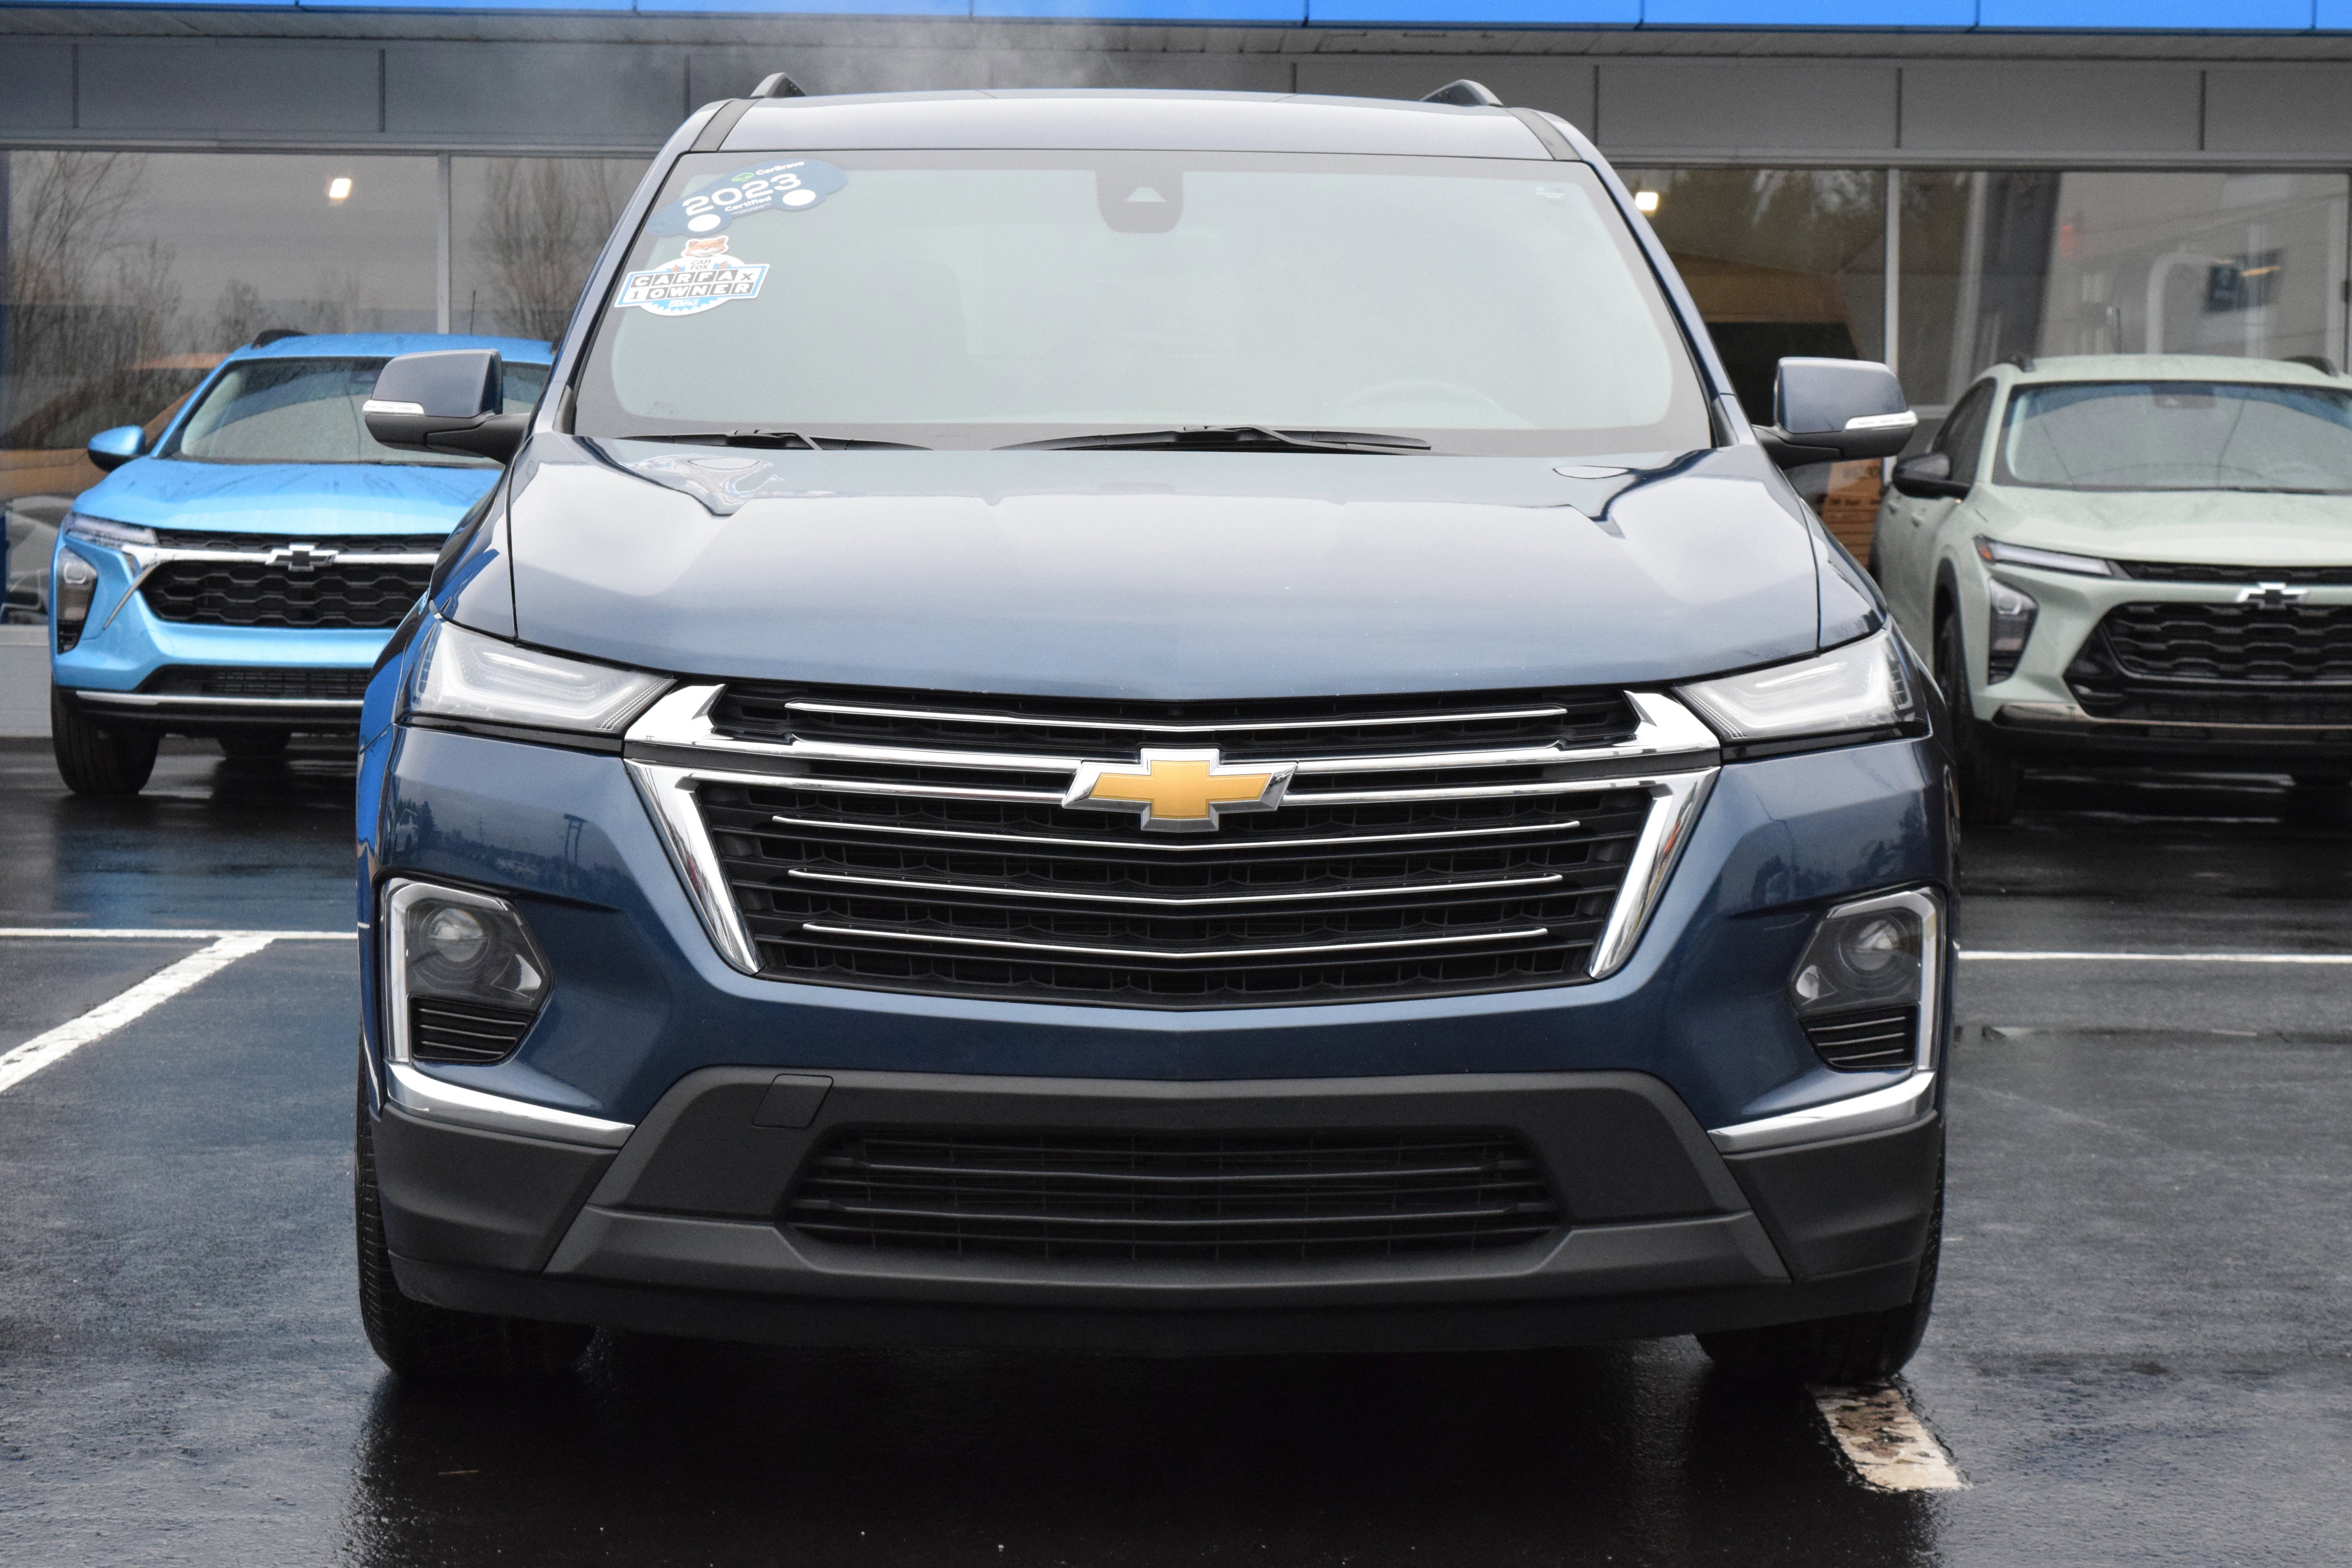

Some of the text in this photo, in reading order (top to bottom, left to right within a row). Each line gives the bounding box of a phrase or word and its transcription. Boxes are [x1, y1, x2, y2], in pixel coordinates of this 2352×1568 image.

[756, 162, 804, 175] CarBravo
[682, 174, 801, 216] 2023
[724, 196, 772, 212] Certified
[635, 272, 755, 286] CARFAX
[630, 283, 751, 300] 1 OWNER
